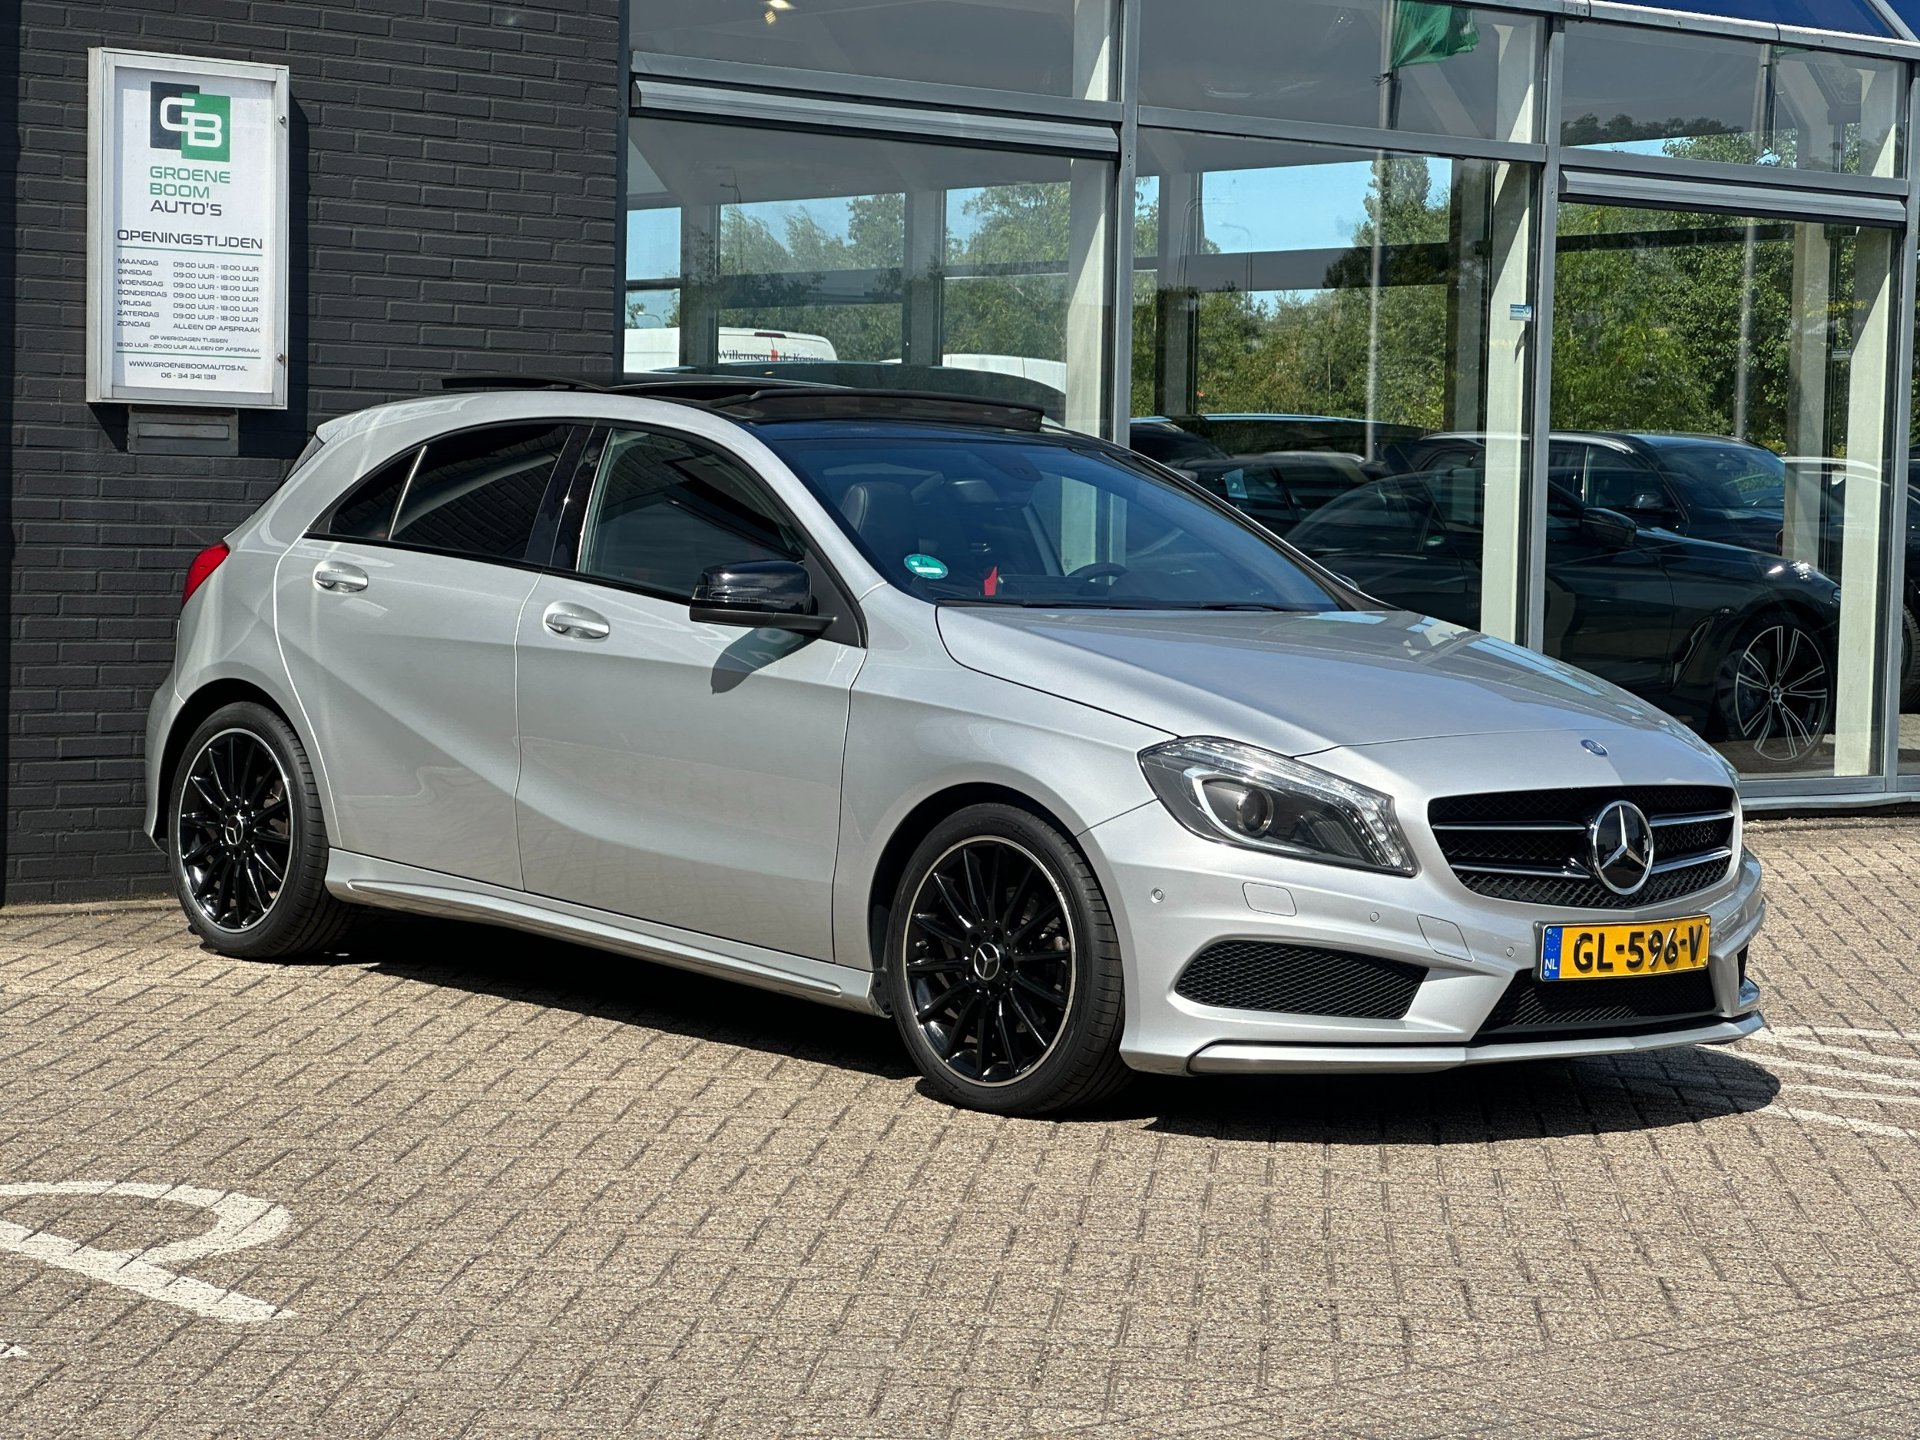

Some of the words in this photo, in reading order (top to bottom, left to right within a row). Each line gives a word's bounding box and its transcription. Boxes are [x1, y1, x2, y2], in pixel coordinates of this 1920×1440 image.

[150, 166, 230, 184] GROENE
[150, 182, 210, 199] BOOM
[150, 200, 222, 216] AUTO'S
[117, 230, 262, 249] OPENINGSTIJDEN
[718, 350, 769, 361] Willemsen
[129, 360, 248, 371] WWW.GROENEBOOMAUTOS.NL
[1573, 924, 1702, 972] GL-596-V
[1544, 958, 1558, 970] NL
